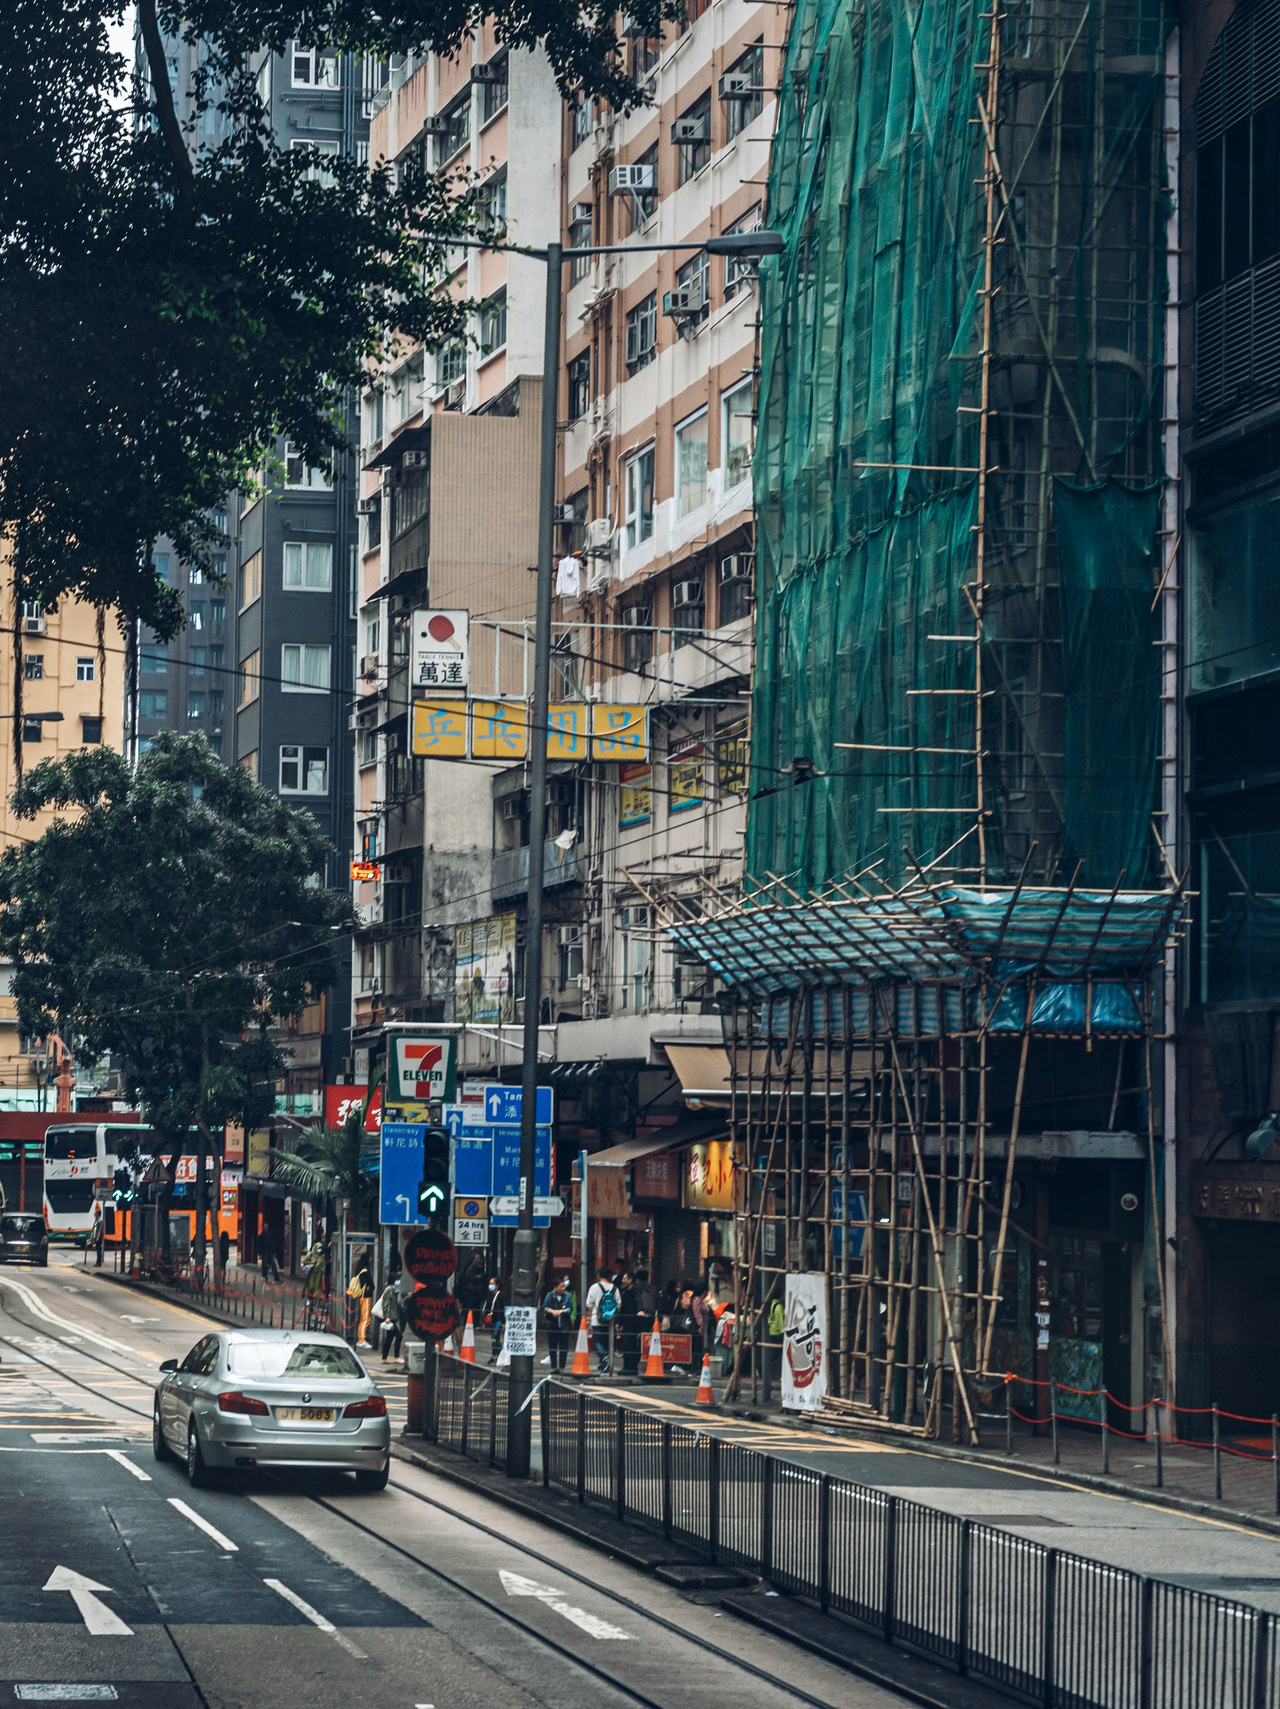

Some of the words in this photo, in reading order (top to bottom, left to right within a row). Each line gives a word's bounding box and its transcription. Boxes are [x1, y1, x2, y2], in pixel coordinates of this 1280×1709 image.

[418, 661, 464, 685] 萬達
[417, 708, 641, 752] 乒乓用品
[385, 1137, 425, 1148] 軒尼詩
[500, 1157, 545, 1168] 軒尼道
[458, 1221, 470, 1229] 24
[471, 1221, 485, 1229] hrs
[461, 1230, 481, 1241] 全日
[281, 1409, 295, 1418] JY
[300, 1409, 331, 1420] 5083
